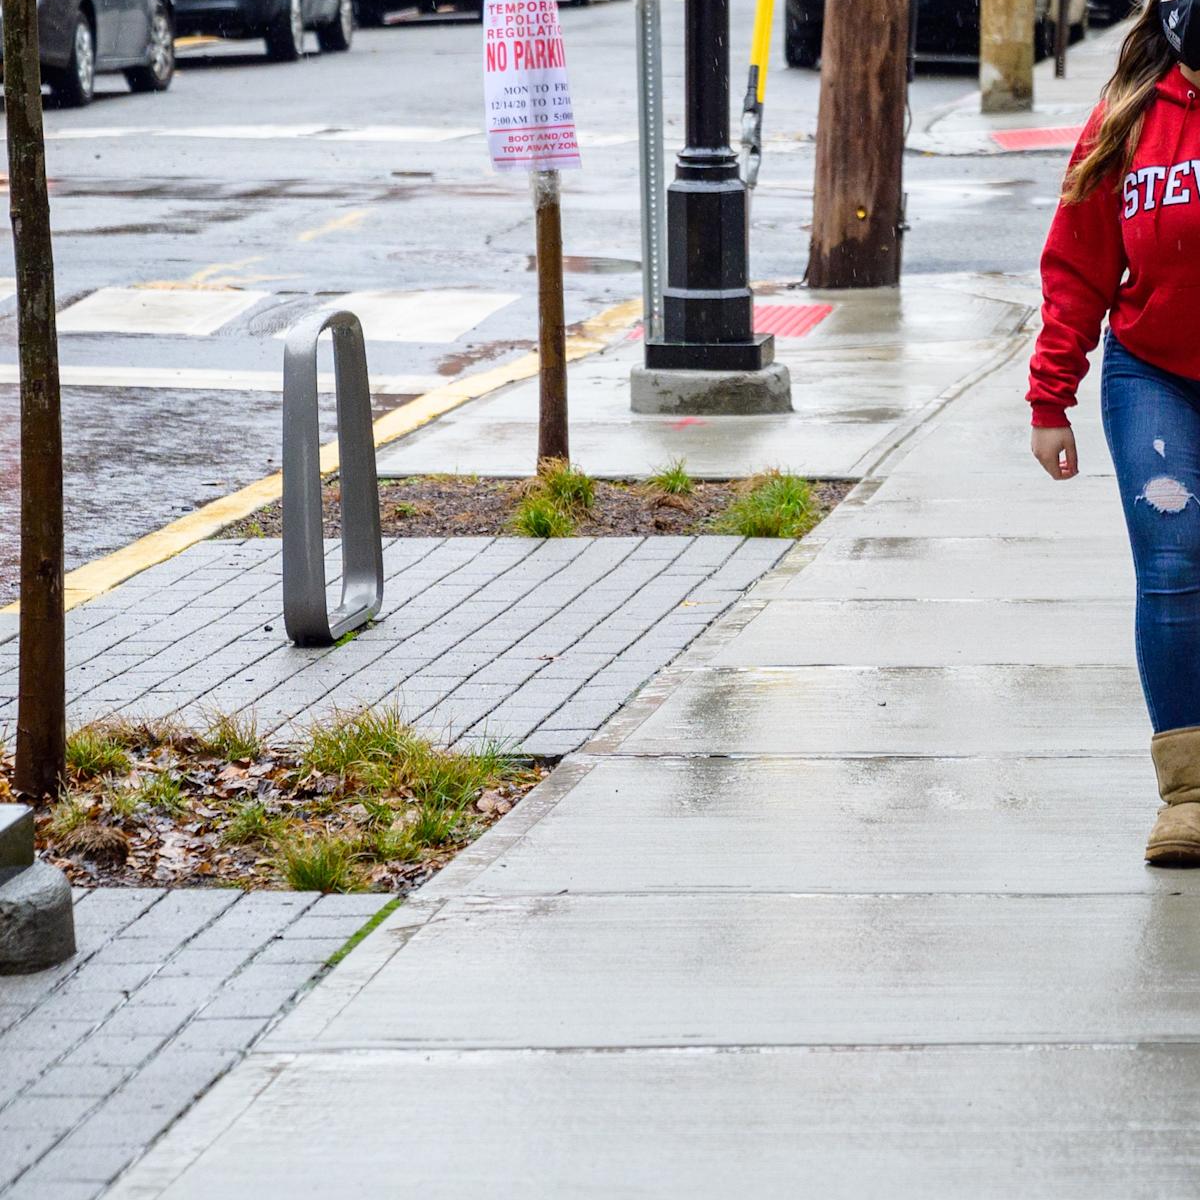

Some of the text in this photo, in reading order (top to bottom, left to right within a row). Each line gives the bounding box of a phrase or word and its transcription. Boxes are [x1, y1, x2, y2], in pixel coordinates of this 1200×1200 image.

[506, 12, 556, 26] POLICE
[487, 41, 507, 72] NO
[504, 86, 529, 95] MON
[533, 84, 549, 93] TO
[491, 100, 526, 110] 12/14/20
[531, 98, 547, 107] TO
[492, 116, 528, 126] 7:00AM
[533, 113, 549, 123] TO
[508, 134, 535, 143] BOOT
[501, 145, 524, 153] TOW
[526, 143, 556, 152] AWAY
